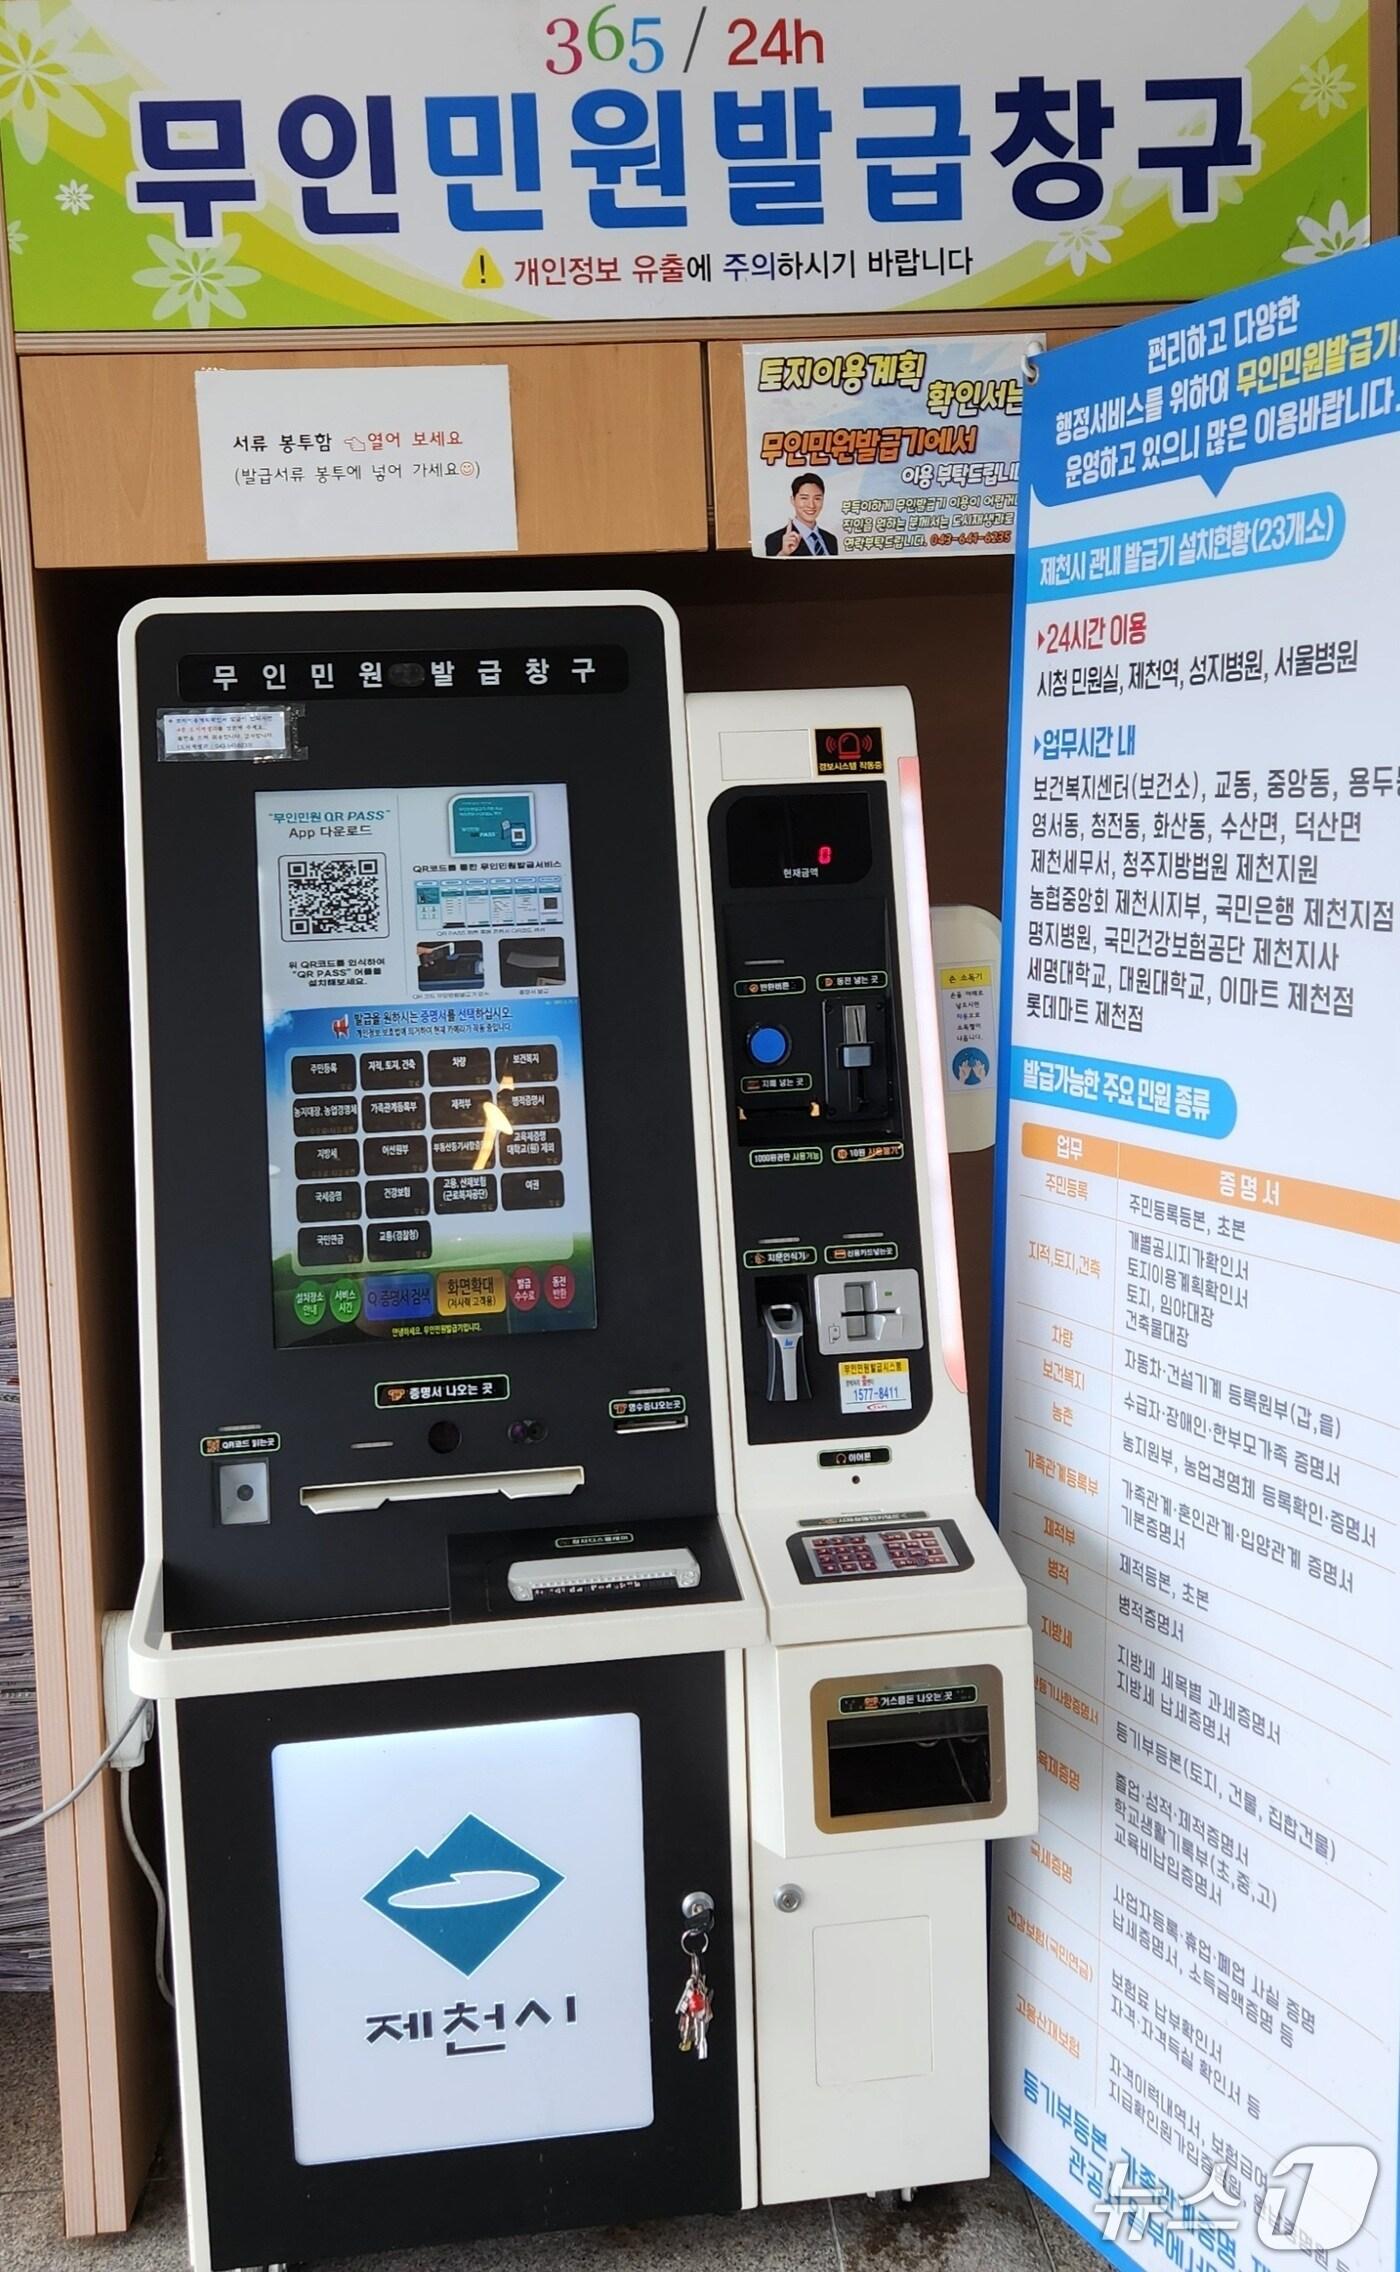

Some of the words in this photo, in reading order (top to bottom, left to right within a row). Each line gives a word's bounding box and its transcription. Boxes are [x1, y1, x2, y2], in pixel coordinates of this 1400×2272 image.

[546, 3, 665, 75] 365
[727, 18, 824, 66] 24h
[131, 76, 1253, 238] 무인민원발급창구
[514, 255, 622, 286] 개인정보
[632, 249, 712, 285] 유출에
[723, 248, 856, 283] 주의하시기
[868, 245, 973, 278] 바랍니다
[1147, 316, 1227, 374] 편리하고
[1234, 294, 1300, 347] 다양한
[758, 350, 926, 394] 토지이용계획
[1055, 386, 1164, 446] 행정서비스를
[1169, 367, 1230, 414] 위하여
[233, 435, 268, 452] 서류
[279, 433, 332, 453] 봉투함
[368, 432, 400, 450] 열어
[412, 431, 463, 447] 보세요
[761, 426, 978, 467] 무인민원발급기에서
[1065, 440, 1136, 489] 운영하고
[1142, 425, 1200, 472] 있으니
[1206, 413, 1248, 457] 많은
[1255, 375, 1400, 444] 이용바랍니다.
[234, 466, 305, 486] (발급서류
[315, 464, 361, 484] 봉투에
[372, 464, 402, 482] 넣어
[902, 464, 934, 489] 이용
[1040, 555, 1086, 586] 제천시
[1089, 552, 1120, 581] 관내
[1124, 535, 1175, 574] 발급기
[1178, 505, 1334, 566] 설치현황(23개소)
[1046, 616, 1106, 654] 24시간
[1111, 611, 1147, 646] 이용
[1037, 668, 1067, 697] 시청
[1072, 663, 1123, 696] 민원실,
[1128, 658, 1184, 690] 제천역,
[1189, 649, 1268, 686] 성지병원,
[1274, 639, 1358, 677] 서울병원
[1042, 726, 1113, 760] 업무시간
[1118, 724, 1136, 756] 내
[1033, 770, 1206, 803] 보건복지센터(보건소),
[1214, 770, 1257, 802] 교동,
[1267, 768, 1338, 801] 중앙동,
[289, 828, 315, 840] App
[320, 825, 373, 838] 다운로드
[324, 811, 344, 822] QR
[1032, 812, 1084, 840] 영서동,
[1091, 811, 1146, 842] 청전동,
[1153, 810, 1212, 843] 화산동,
[1220, 811, 1285, 844] 수산면,
[1295, 811, 1362, 842] 덕산면
[783, 868, 819, 879] 현재금액
[1030, 849, 1115, 879] 제천세무서,
[1123, 850, 1228, 882] 청주지방법원
[1235, 853, 1318, 885] 제천지원
[1030, 885, 1108, 914] 농협중앙회
[1115, 887, 1207, 924] 제천시지부,
[1216, 892, 1295, 927] 국민은행
[1303, 897, 1394, 933] 제천지점
[1028, 921, 1097, 953] 명지병원,
[1104, 925, 1245, 966] 국민건강보험공단
[1253, 936, 1339, 971] 제천지사
[1027, 956, 1112, 993] 세명대학교,
[1119, 964, 1211, 1005] 대원대학교,
[1220, 976, 1279, 1009] 이마트
[1288, 980, 1354, 1018] 제천점
[1026, 992, 1089, 1025] 롯데마트
[1095, 999, 1143, 1033] 제천점
[1022, 1058, 1100, 1101] 발급가능한
[1103, 1071, 1134, 1106] 주요
[1138, 1078, 1172, 1116] 민원
[1175, 1083, 1211, 1121] 종류
[1056, 1134, 1083, 1161] 업무
[1045, 1173, 1089, 1201] 주민등록
[1129, 1192, 1212, 1235] 주민등록등본,
[1217, 1215, 1246, 1242] 초본
[1128, 1230, 1249, 1282] 개별공시지가확인서
[447, 1276, 494, 1296] 화면확대
[1127, 1256, 1248, 1310] 토지이용계획확인서
[1127, 1283, 1156, 1313] 토지,
[1160, 1294, 1214, 1329] 임야대장
[1051, 1325, 1073, 1349] 차량
[1126, 1309, 1190, 1349] 건축물대장
[409, 1387, 442, 1400] 증명서
[446, 1384, 478, 1396] 나오는
[482, 1382, 493, 1394] 곳
[853, 1386, 898, 1402] 1577-8411
[1042, 1358, 1085, 1392] 보건복지
[1051, 1401, 1073, 1428] 농촌
[848, 1452, 872, 1463] 이어폰
[1025, 1448, 1100, 1497] 가족관계등록부
[1122, 1431, 1178, 1475] 농지원부,
[1184, 1454, 1255, 1500] 농업경영체
[1294, 1449, 1341, 1487] 증명서
[1043, 1515, 1076, 1547] 제적부
[1121, 1504, 1186, 1551] 기본증명서
[1047, 1556, 1070, 1585] 병적
[1119, 1552, 1176, 1598] 제적등본,
[1182, 1582, 1210, 1612] 초본
[1307, 1554, 1354, 1595] 증명서
[1041, 1615, 1073, 1649] 지방세
[1118, 1593, 1184, 1643] 병적증명서
[881, 1695, 914, 1706] 거스름돈
[916, 1692, 942, 1703] 나오는
[943, 1690, 953, 1701] 곳
[1117, 1644, 1155, 1681] 지방세
[1161, 1667, 1202, 1704] 세목별
[1208, 1689, 1281, 1745] 과세증명서
[1117, 1670, 1155, 1707] 지방세
[1160, 1692, 1231, 1747] 납세증명서
[1116, 1720, 1224, 1796] 등기부등본(토지,
[1229, 1782, 1263, 1824] 건물,
[1268, 1804, 1336, 1863] 집합건물)
[1030, 1839, 1073, 1885] 국세증명
[1114, 1823, 1223, 1907] 교육비납입증명서
[1112, 1911, 1183, 1976] 납세증명서,
[1188, 1962, 1274, 2036] 소득금액증명
[1279, 2022, 1294, 2050] 등
[365, 1994, 577, 2057] 제천시
[1111, 1967, 1150, 2012] 보험료
[1154, 1997, 1223, 2064] 납부확인서
[1251, 1974, 1281, 2012] 사실
[1286, 1996, 1316, 2037] 증명
[1199, 2058, 1241, 2107] 확인서
[1247, 2093, 1261, 2121] 등
